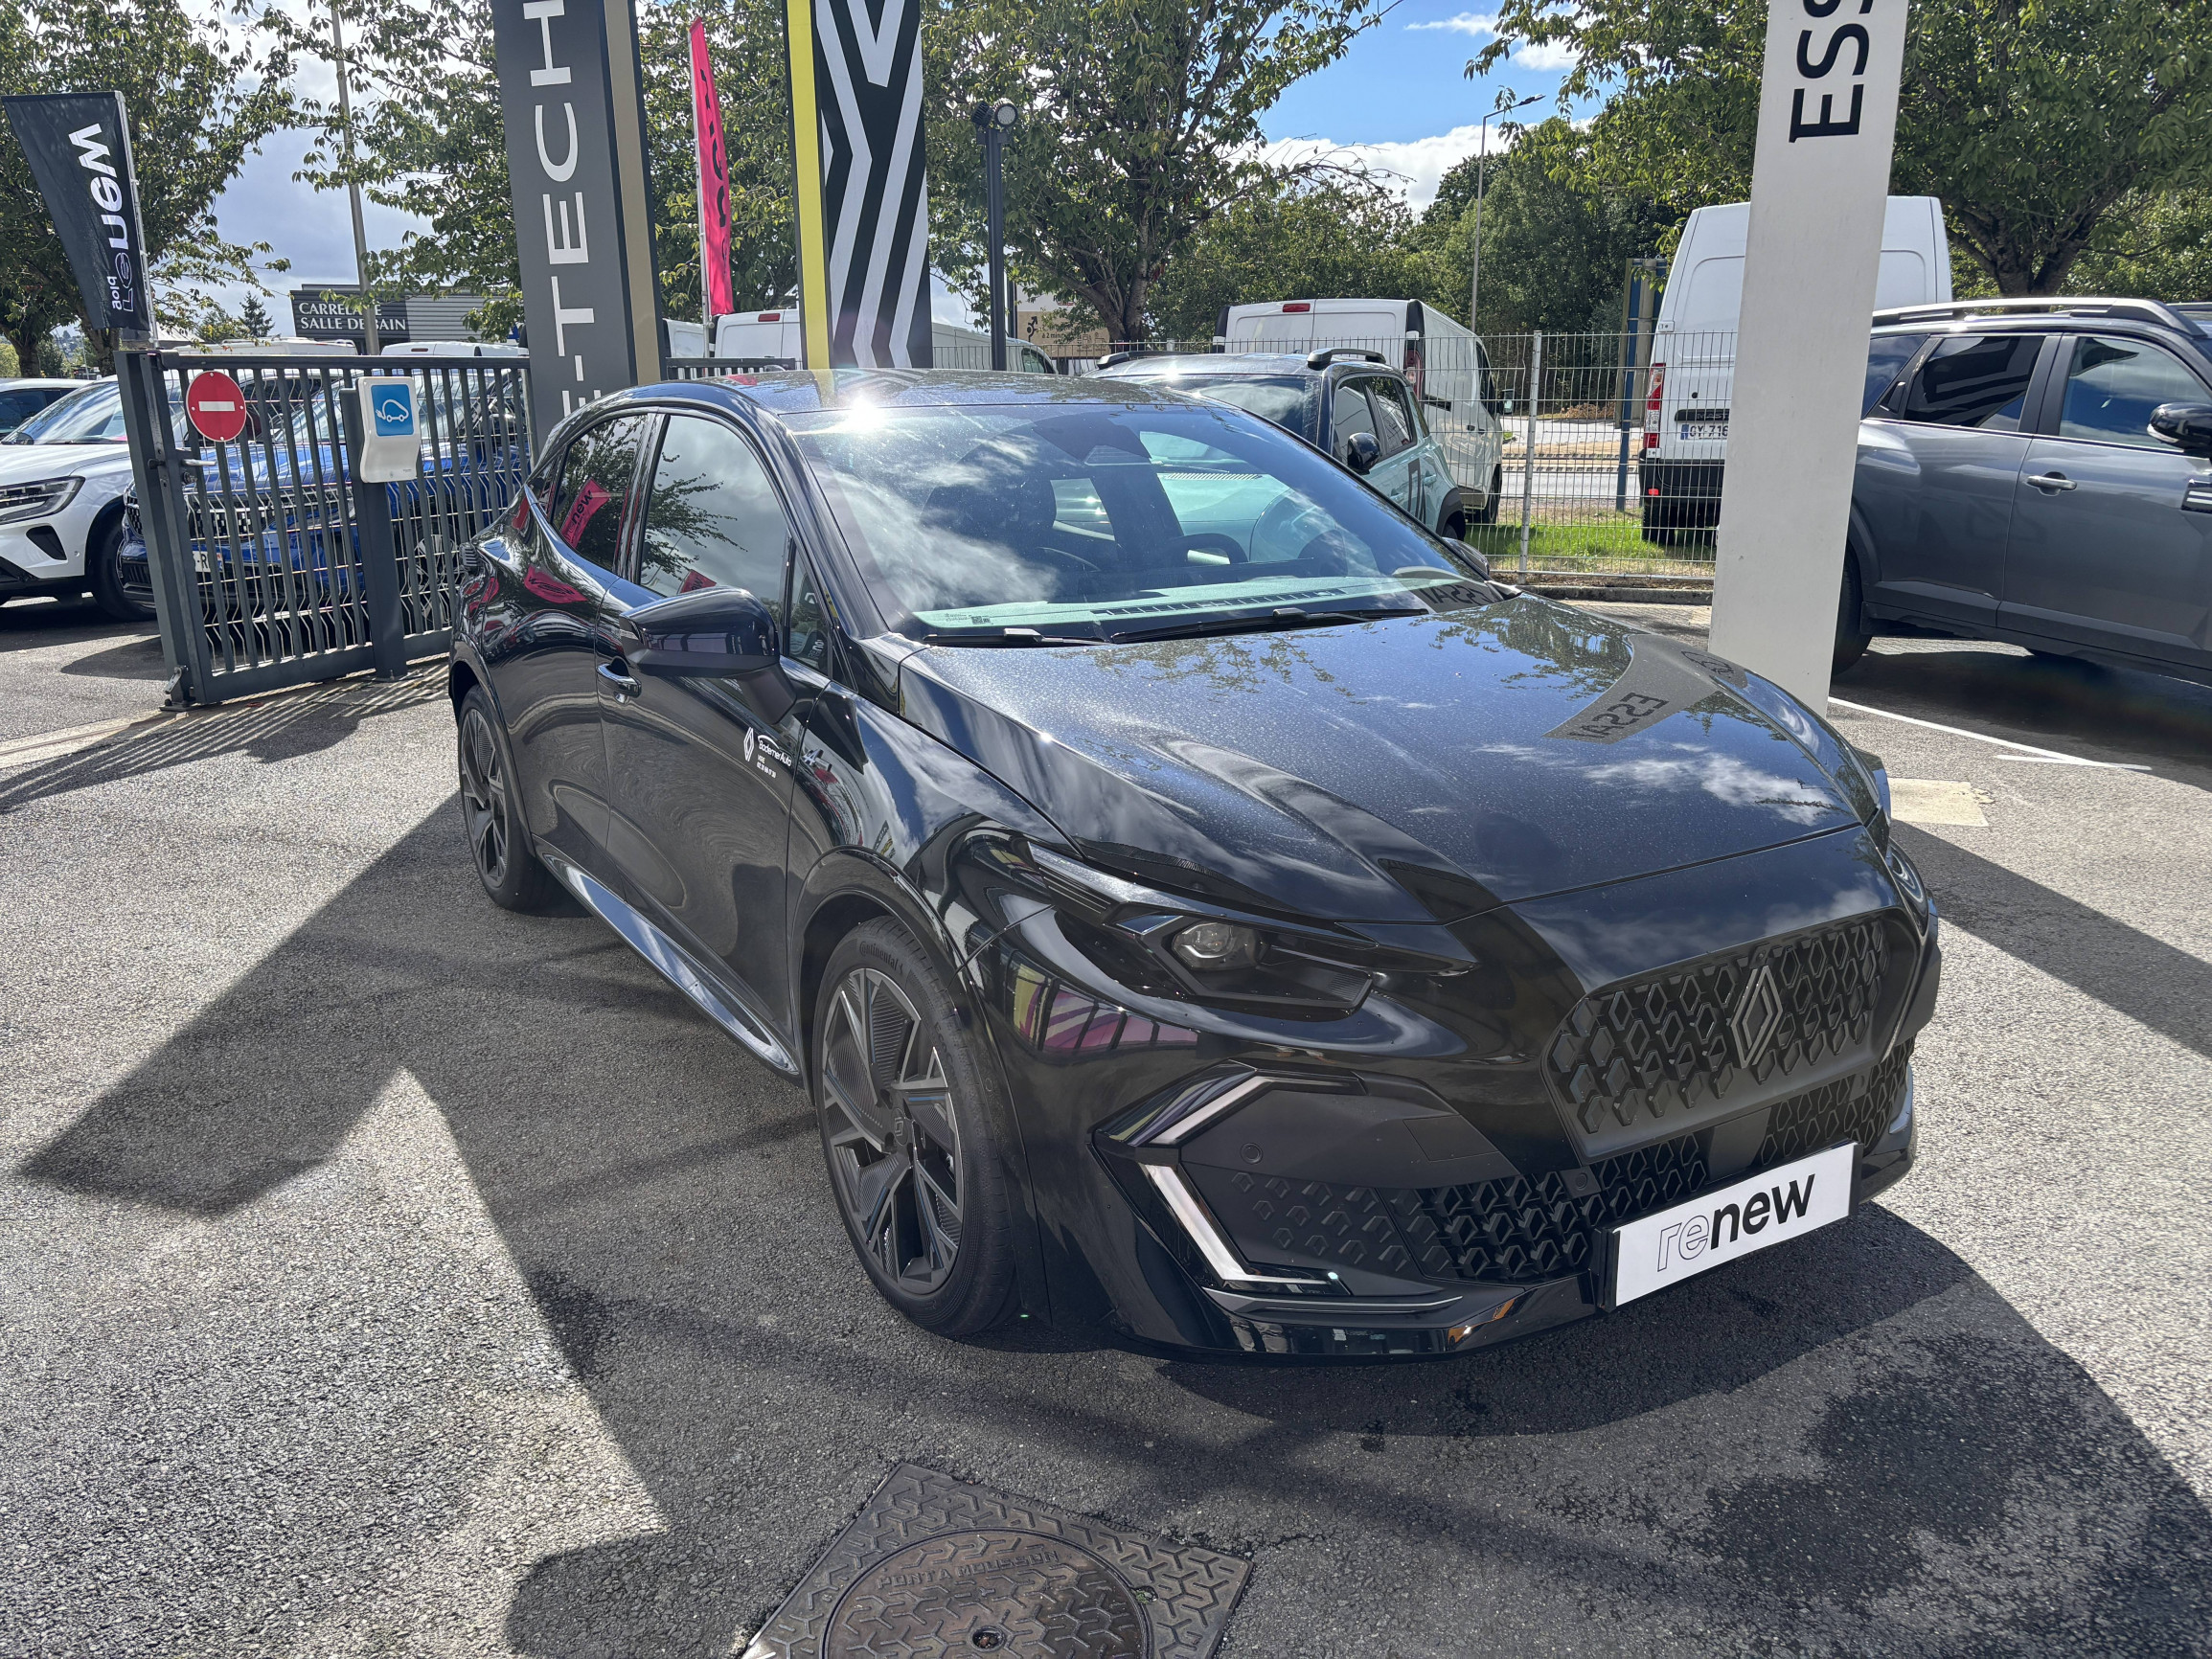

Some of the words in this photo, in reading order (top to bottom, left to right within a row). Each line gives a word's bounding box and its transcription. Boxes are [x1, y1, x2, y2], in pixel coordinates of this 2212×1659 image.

[523, 0, 601, 417] -TECH
[299, 303, 381, 315] CARRELAE
[301, 317, 342, 330] SALLE
[1657, 1173, 1815, 1272] renew
